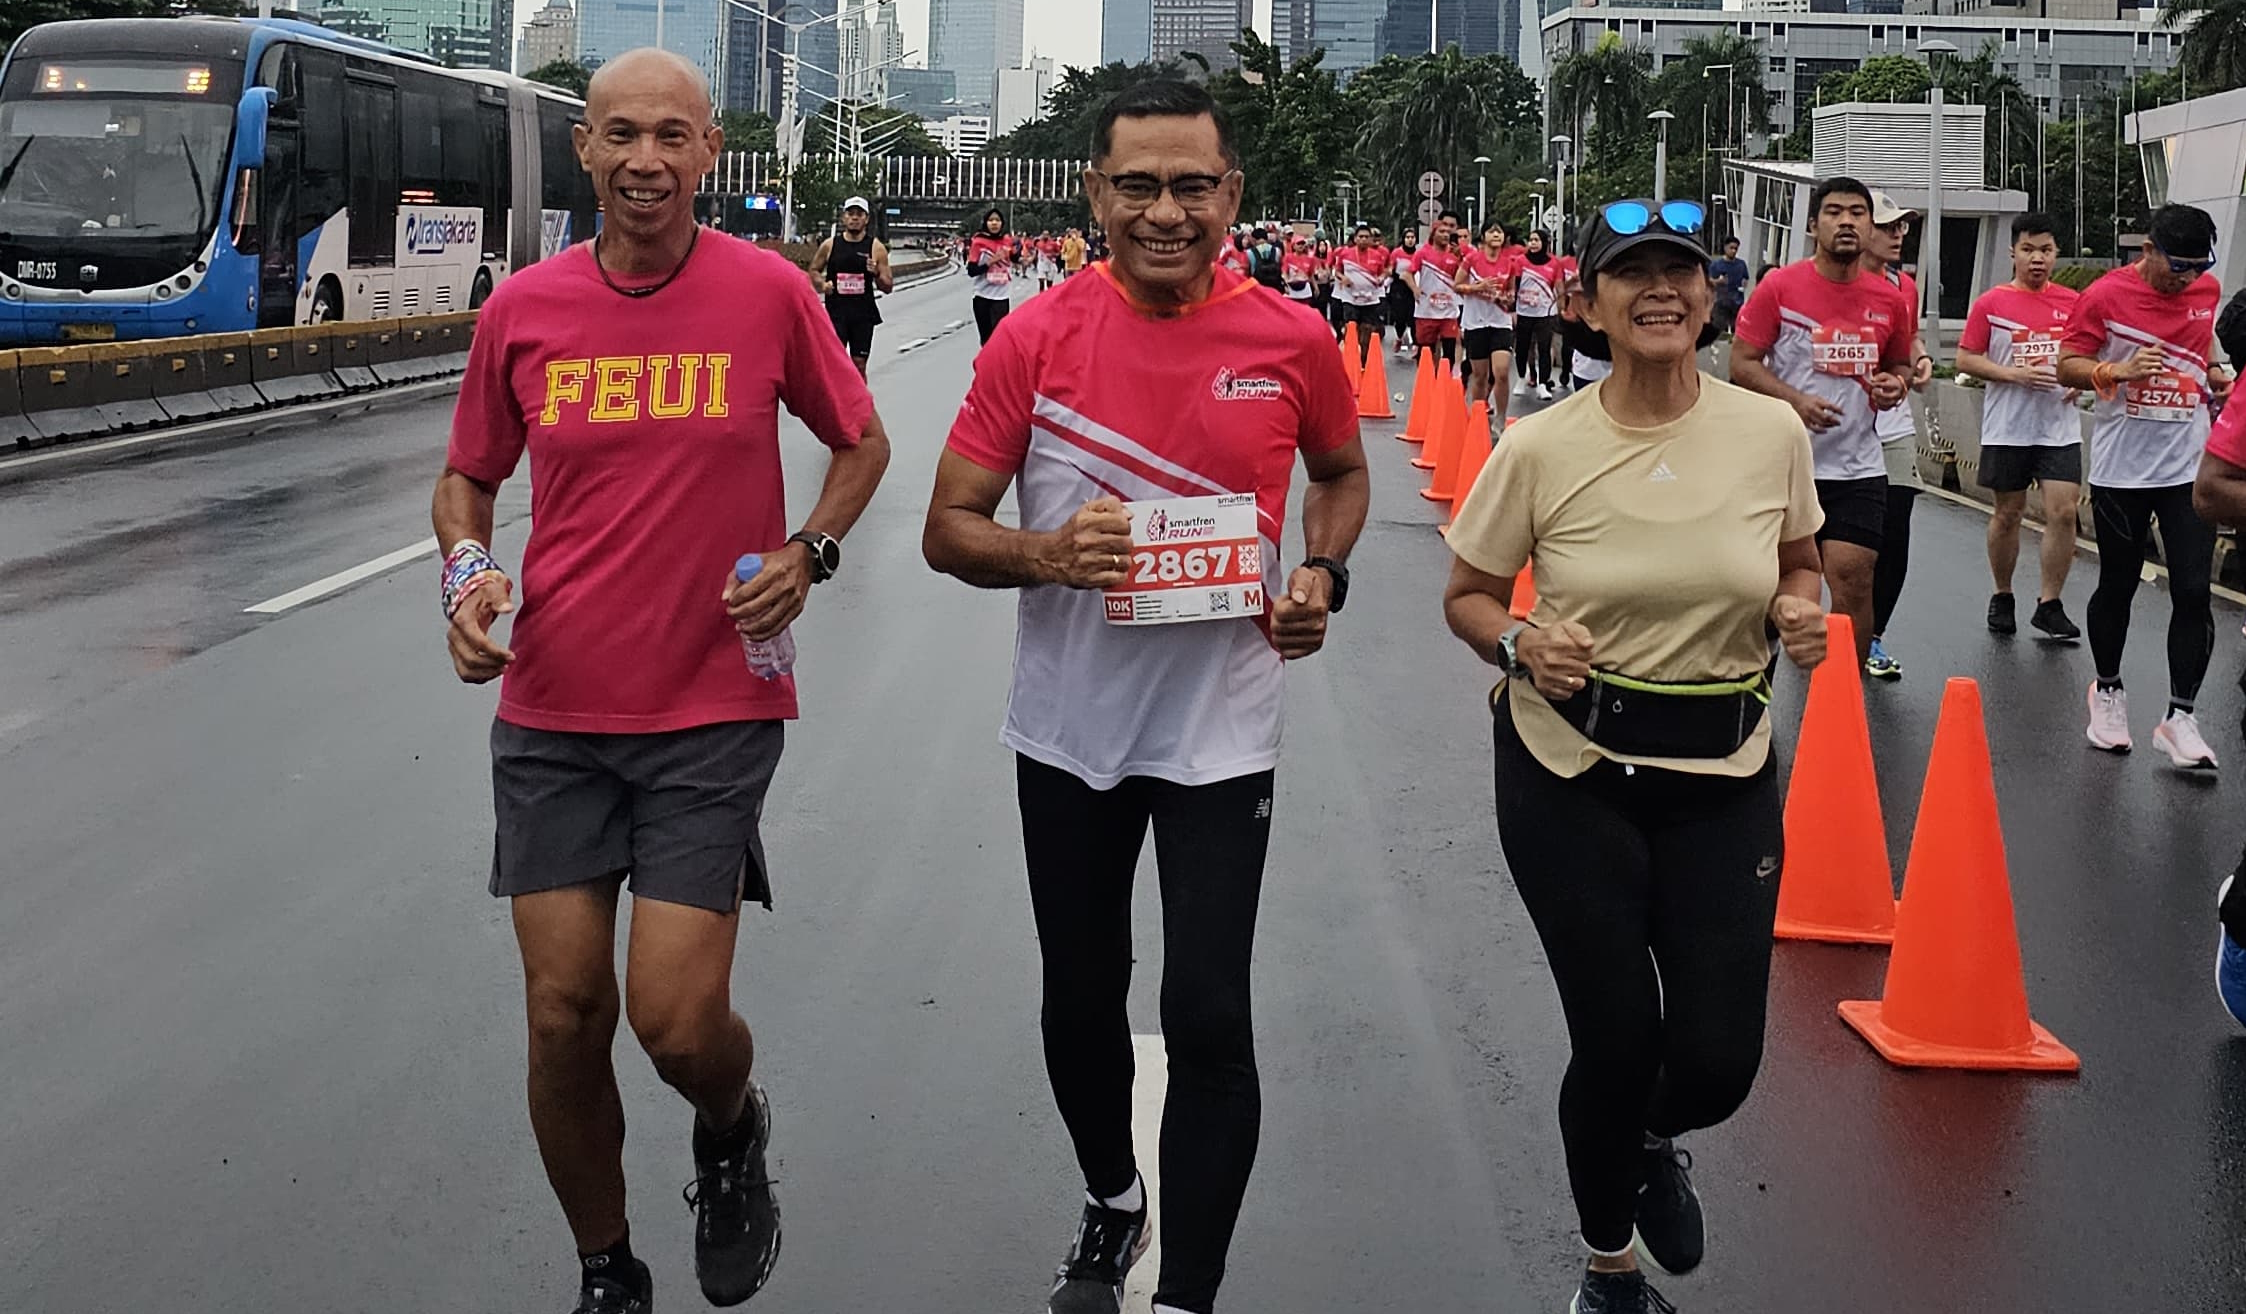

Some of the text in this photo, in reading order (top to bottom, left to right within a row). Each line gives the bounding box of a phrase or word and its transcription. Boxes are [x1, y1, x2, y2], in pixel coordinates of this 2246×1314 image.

[417, 213, 476, 244] transjakarta
[1827, 347, 1865, 359] 2665
[2025, 343, 2055, 354] 2973
[540, 353, 731, 425] FEUI
[1236, 379, 1279, 388] smartfren
[1235, 388, 1269, 398] RUN
[2141, 389, 2183, 405] 2574
[1169, 516, 1215, 528] smartfren
[1168, 527, 1203, 539] RUN
[1133, 546, 1231, 584] 2867
[1243, 589, 1261, 608] M
[1106, 600, 1131, 612] 10K
